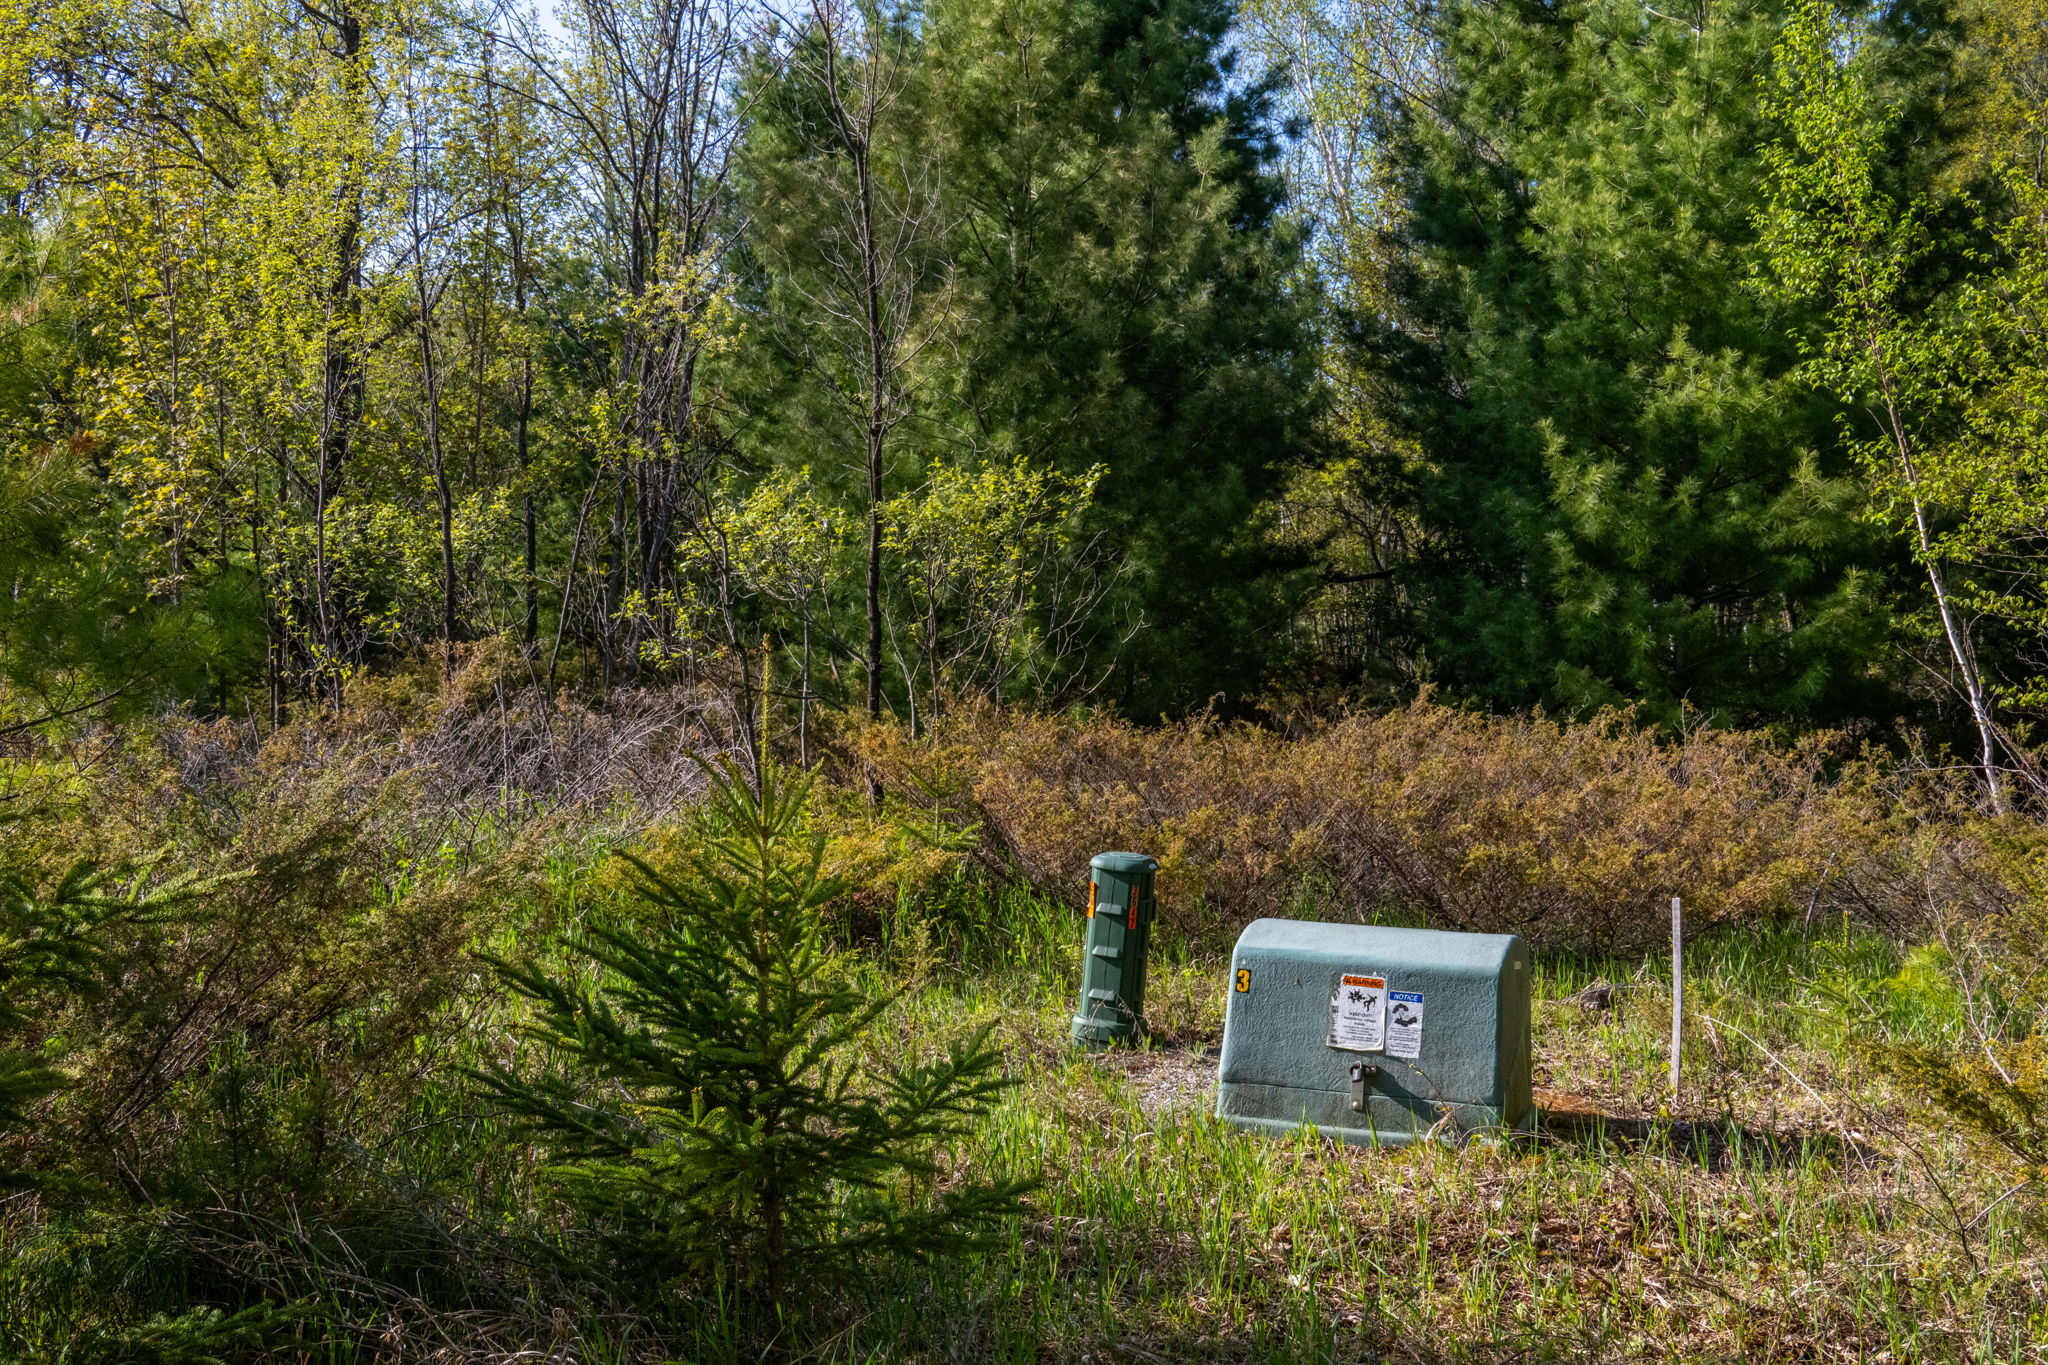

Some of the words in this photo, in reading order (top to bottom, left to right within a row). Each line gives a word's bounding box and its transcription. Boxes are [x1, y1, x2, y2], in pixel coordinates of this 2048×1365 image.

[1237, 969, 1250, 992] 3
[1352, 979, 1382, 987] WARNING
[1394, 993, 1418, 1001] NOTICE
